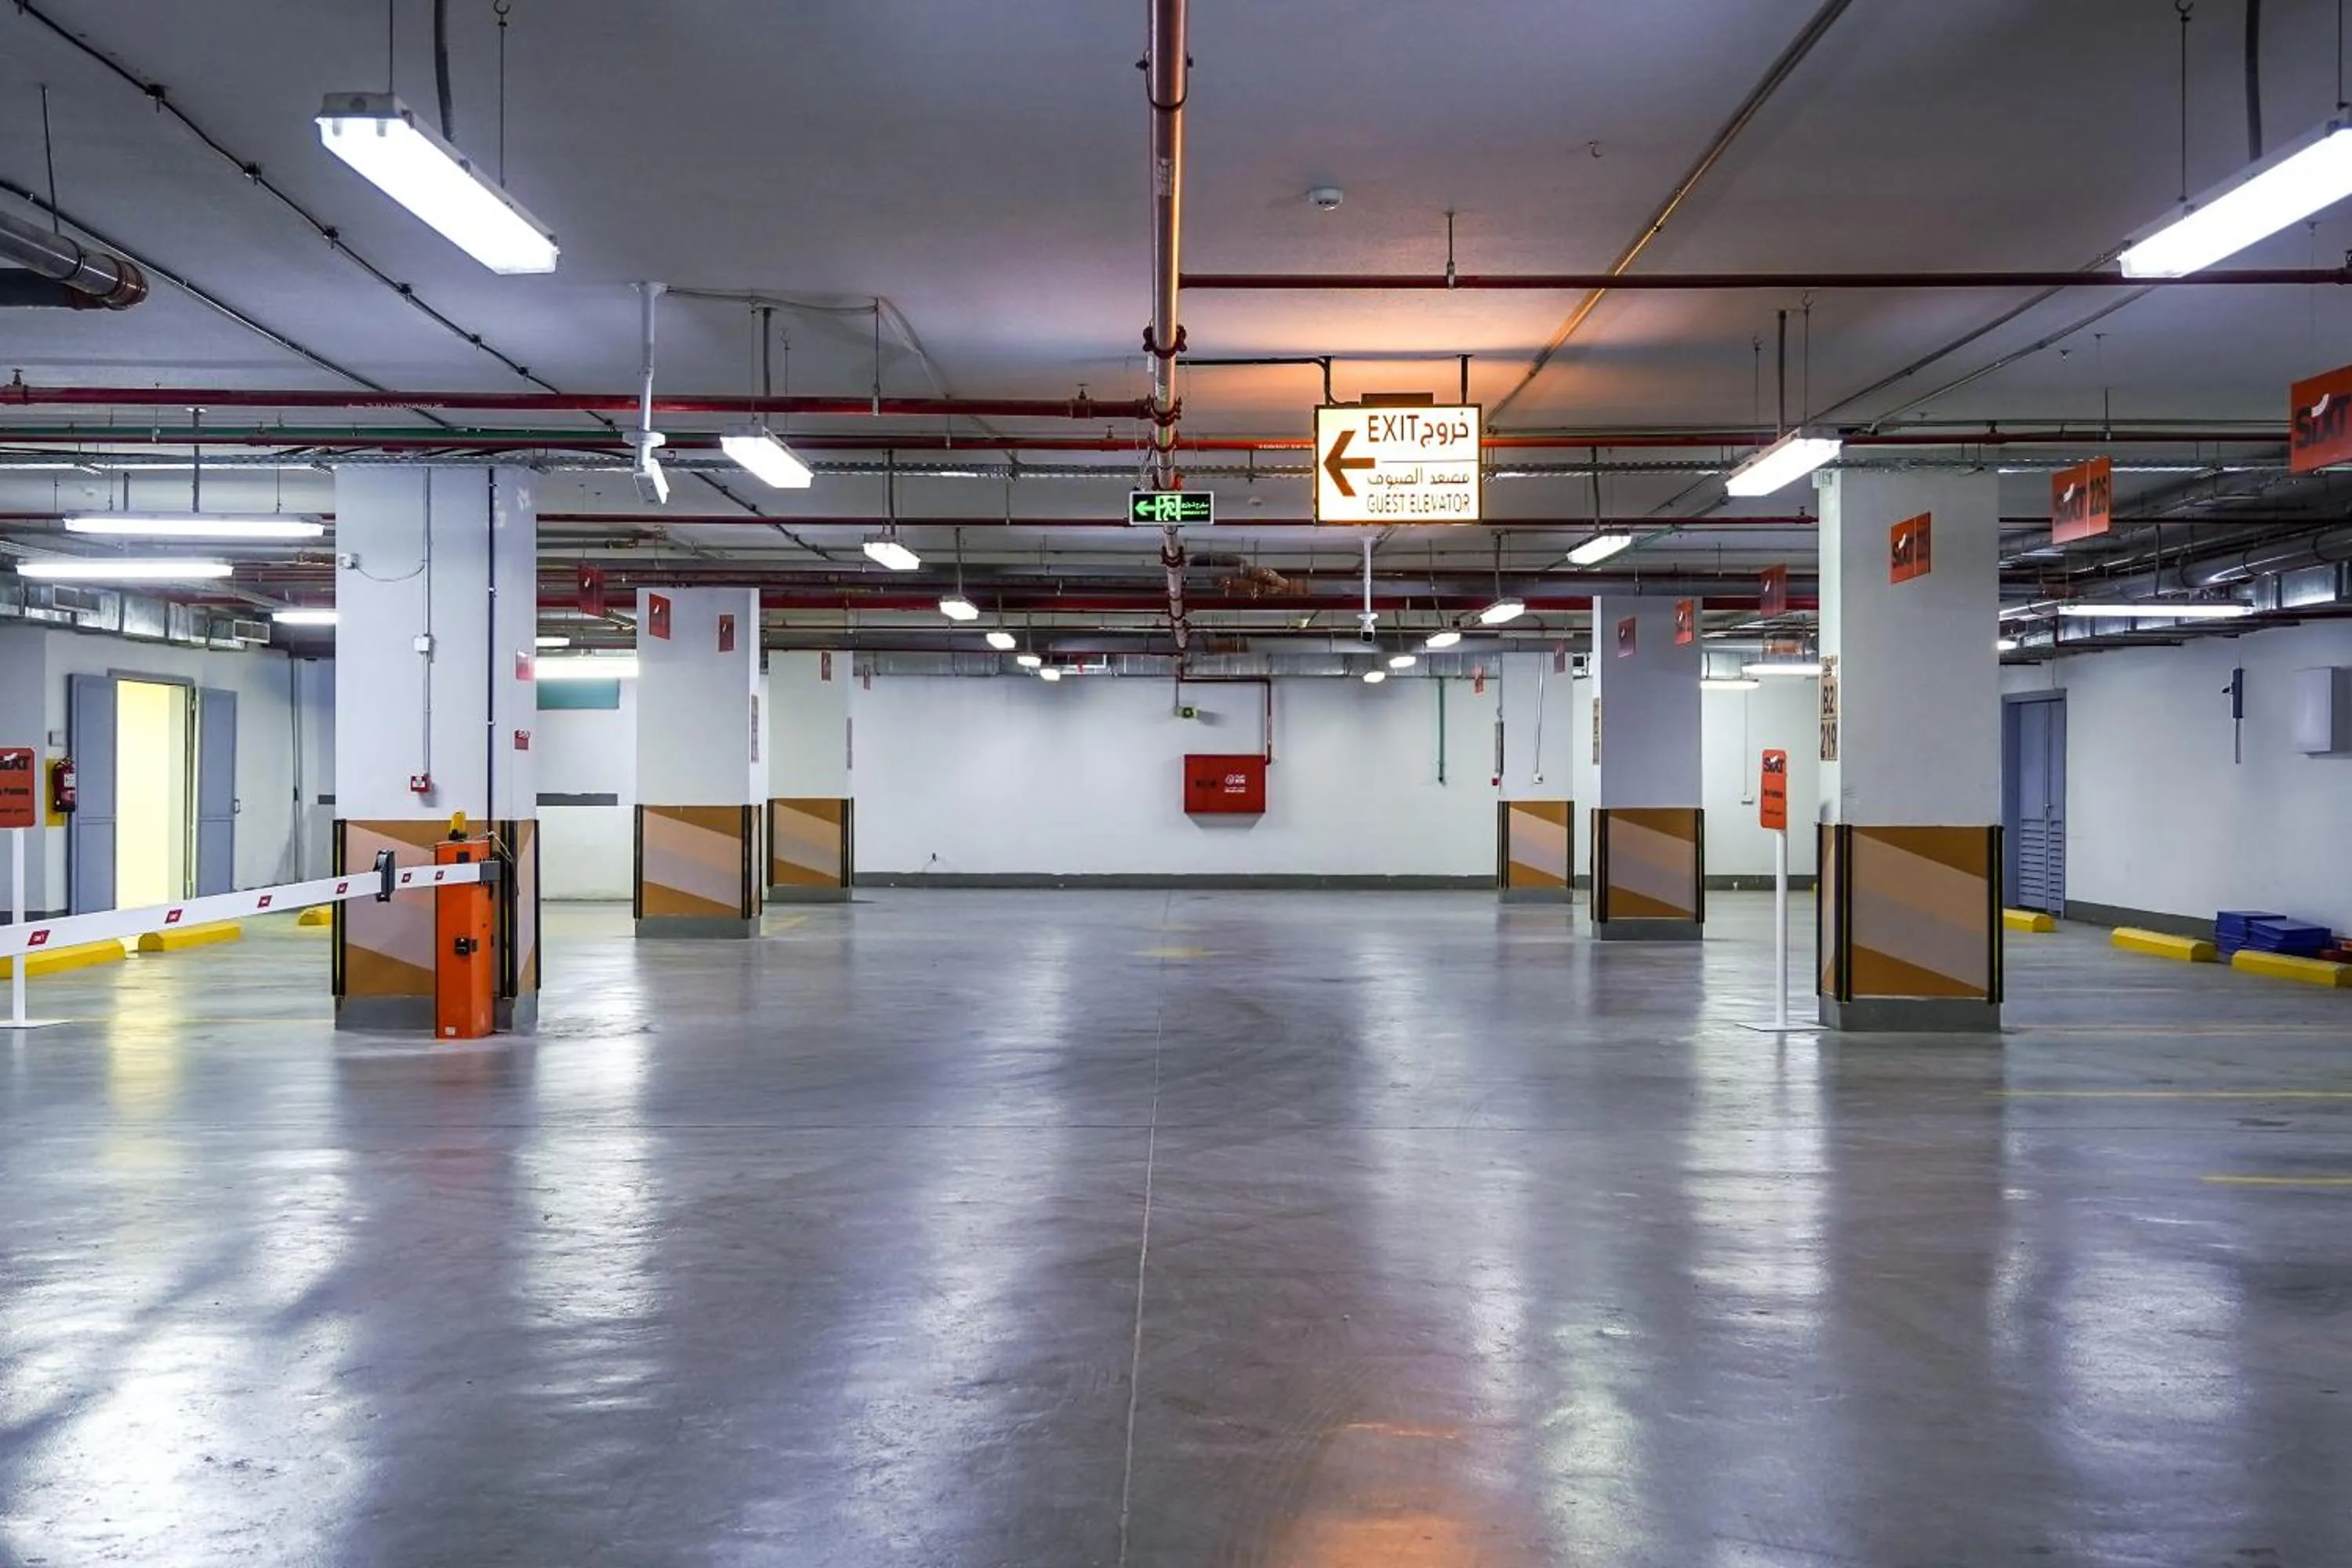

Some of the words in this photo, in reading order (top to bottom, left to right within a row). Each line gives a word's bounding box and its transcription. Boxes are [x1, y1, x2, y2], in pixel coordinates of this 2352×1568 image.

[1368, 415, 1420, 442] EXIT
[1420, 412, 1469, 448] خروج
[1429, 472, 1470, 485] مصعد
[1367, 493, 1406, 514] GUEST
[1410, 493, 1471, 514] ELEVATOR
[1824, 685, 1835, 713] B2
[1820, 722, 1838, 759] 219
